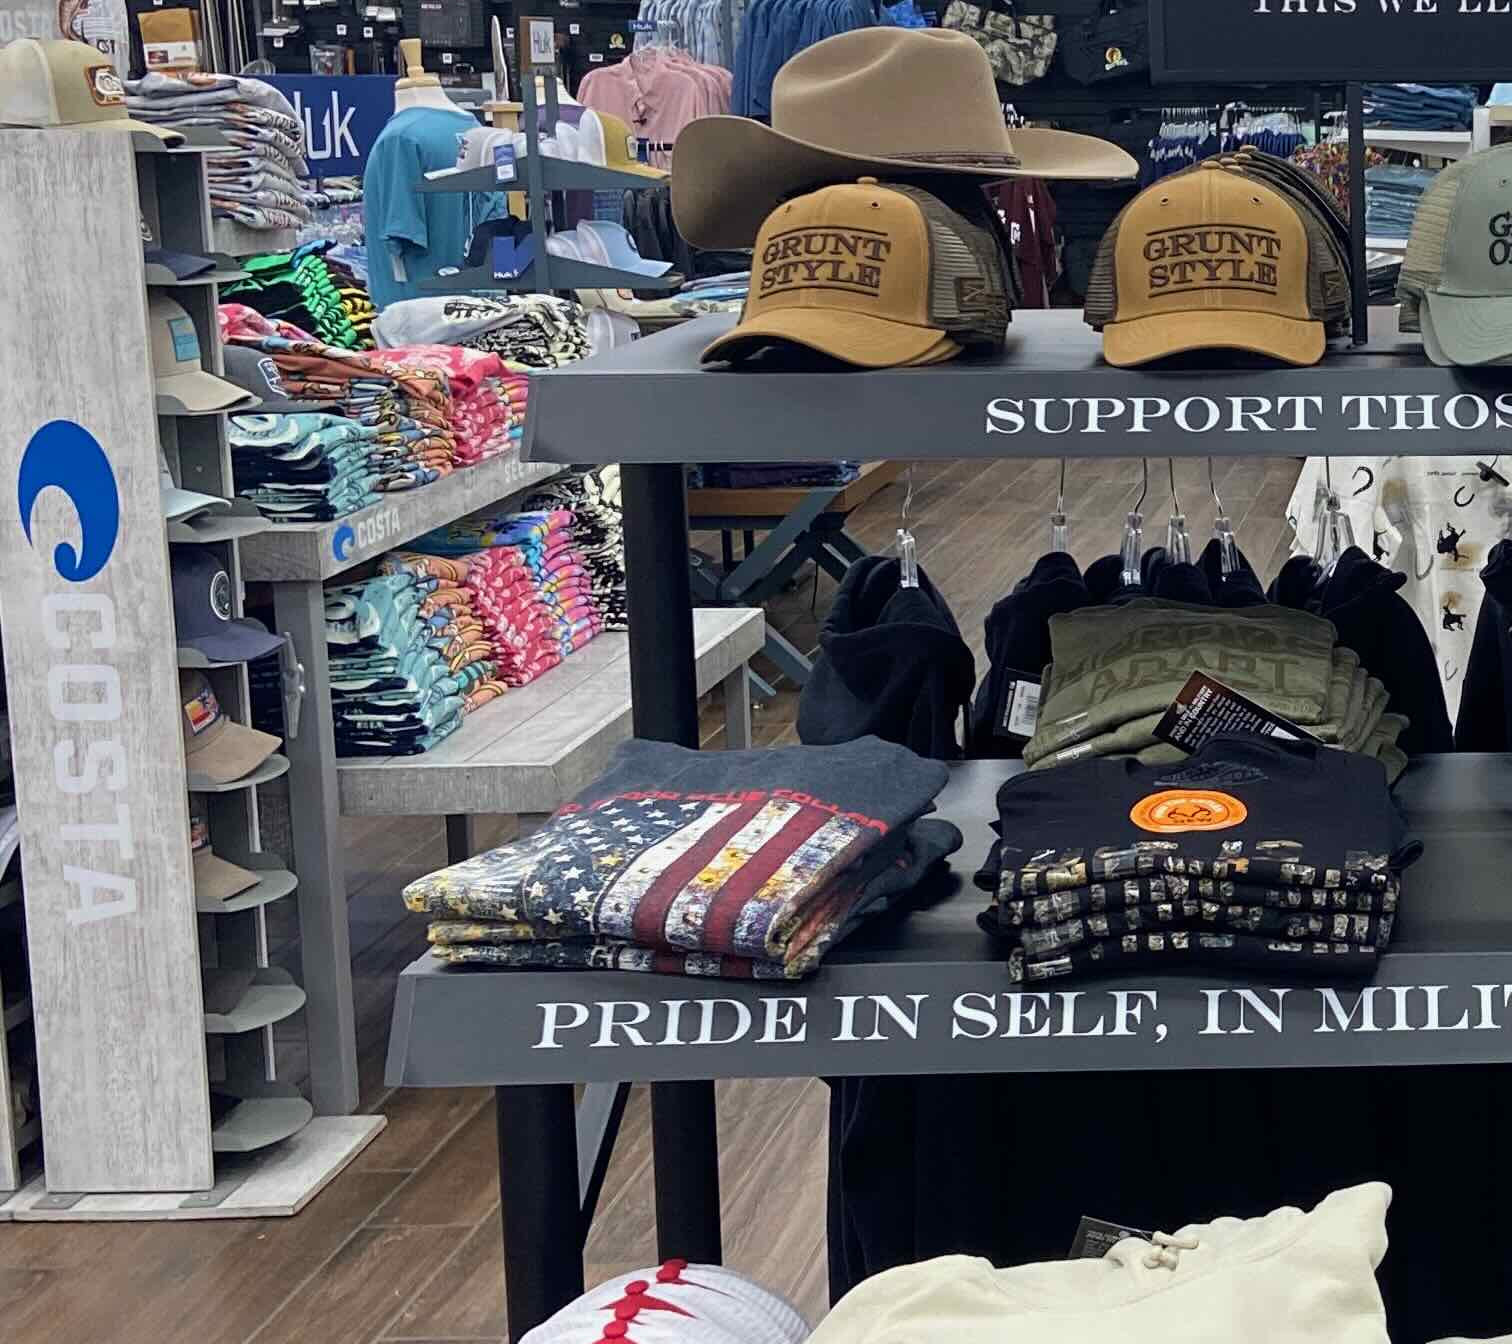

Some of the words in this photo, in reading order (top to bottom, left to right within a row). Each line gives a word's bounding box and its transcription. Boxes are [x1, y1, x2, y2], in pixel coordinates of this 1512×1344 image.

[763, 233, 891, 265] GRUNT
[1144, 232, 1281, 261] GRUNT
[760, 260, 881, 290] STYLE
[1150, 259, 1277, 288] STYLE
[985, 395, 1323, 434] SUPPORT
[357, 508, 401, 549] COSTA
[42, 590, 136, 927] COSTA
[531, 997, 808, 1049] PRIDE
[831, 994, 929, 1042] IN
[951, 990, 1168, 1043] SELF,
[1198, 987, 1294, 1035] IN
